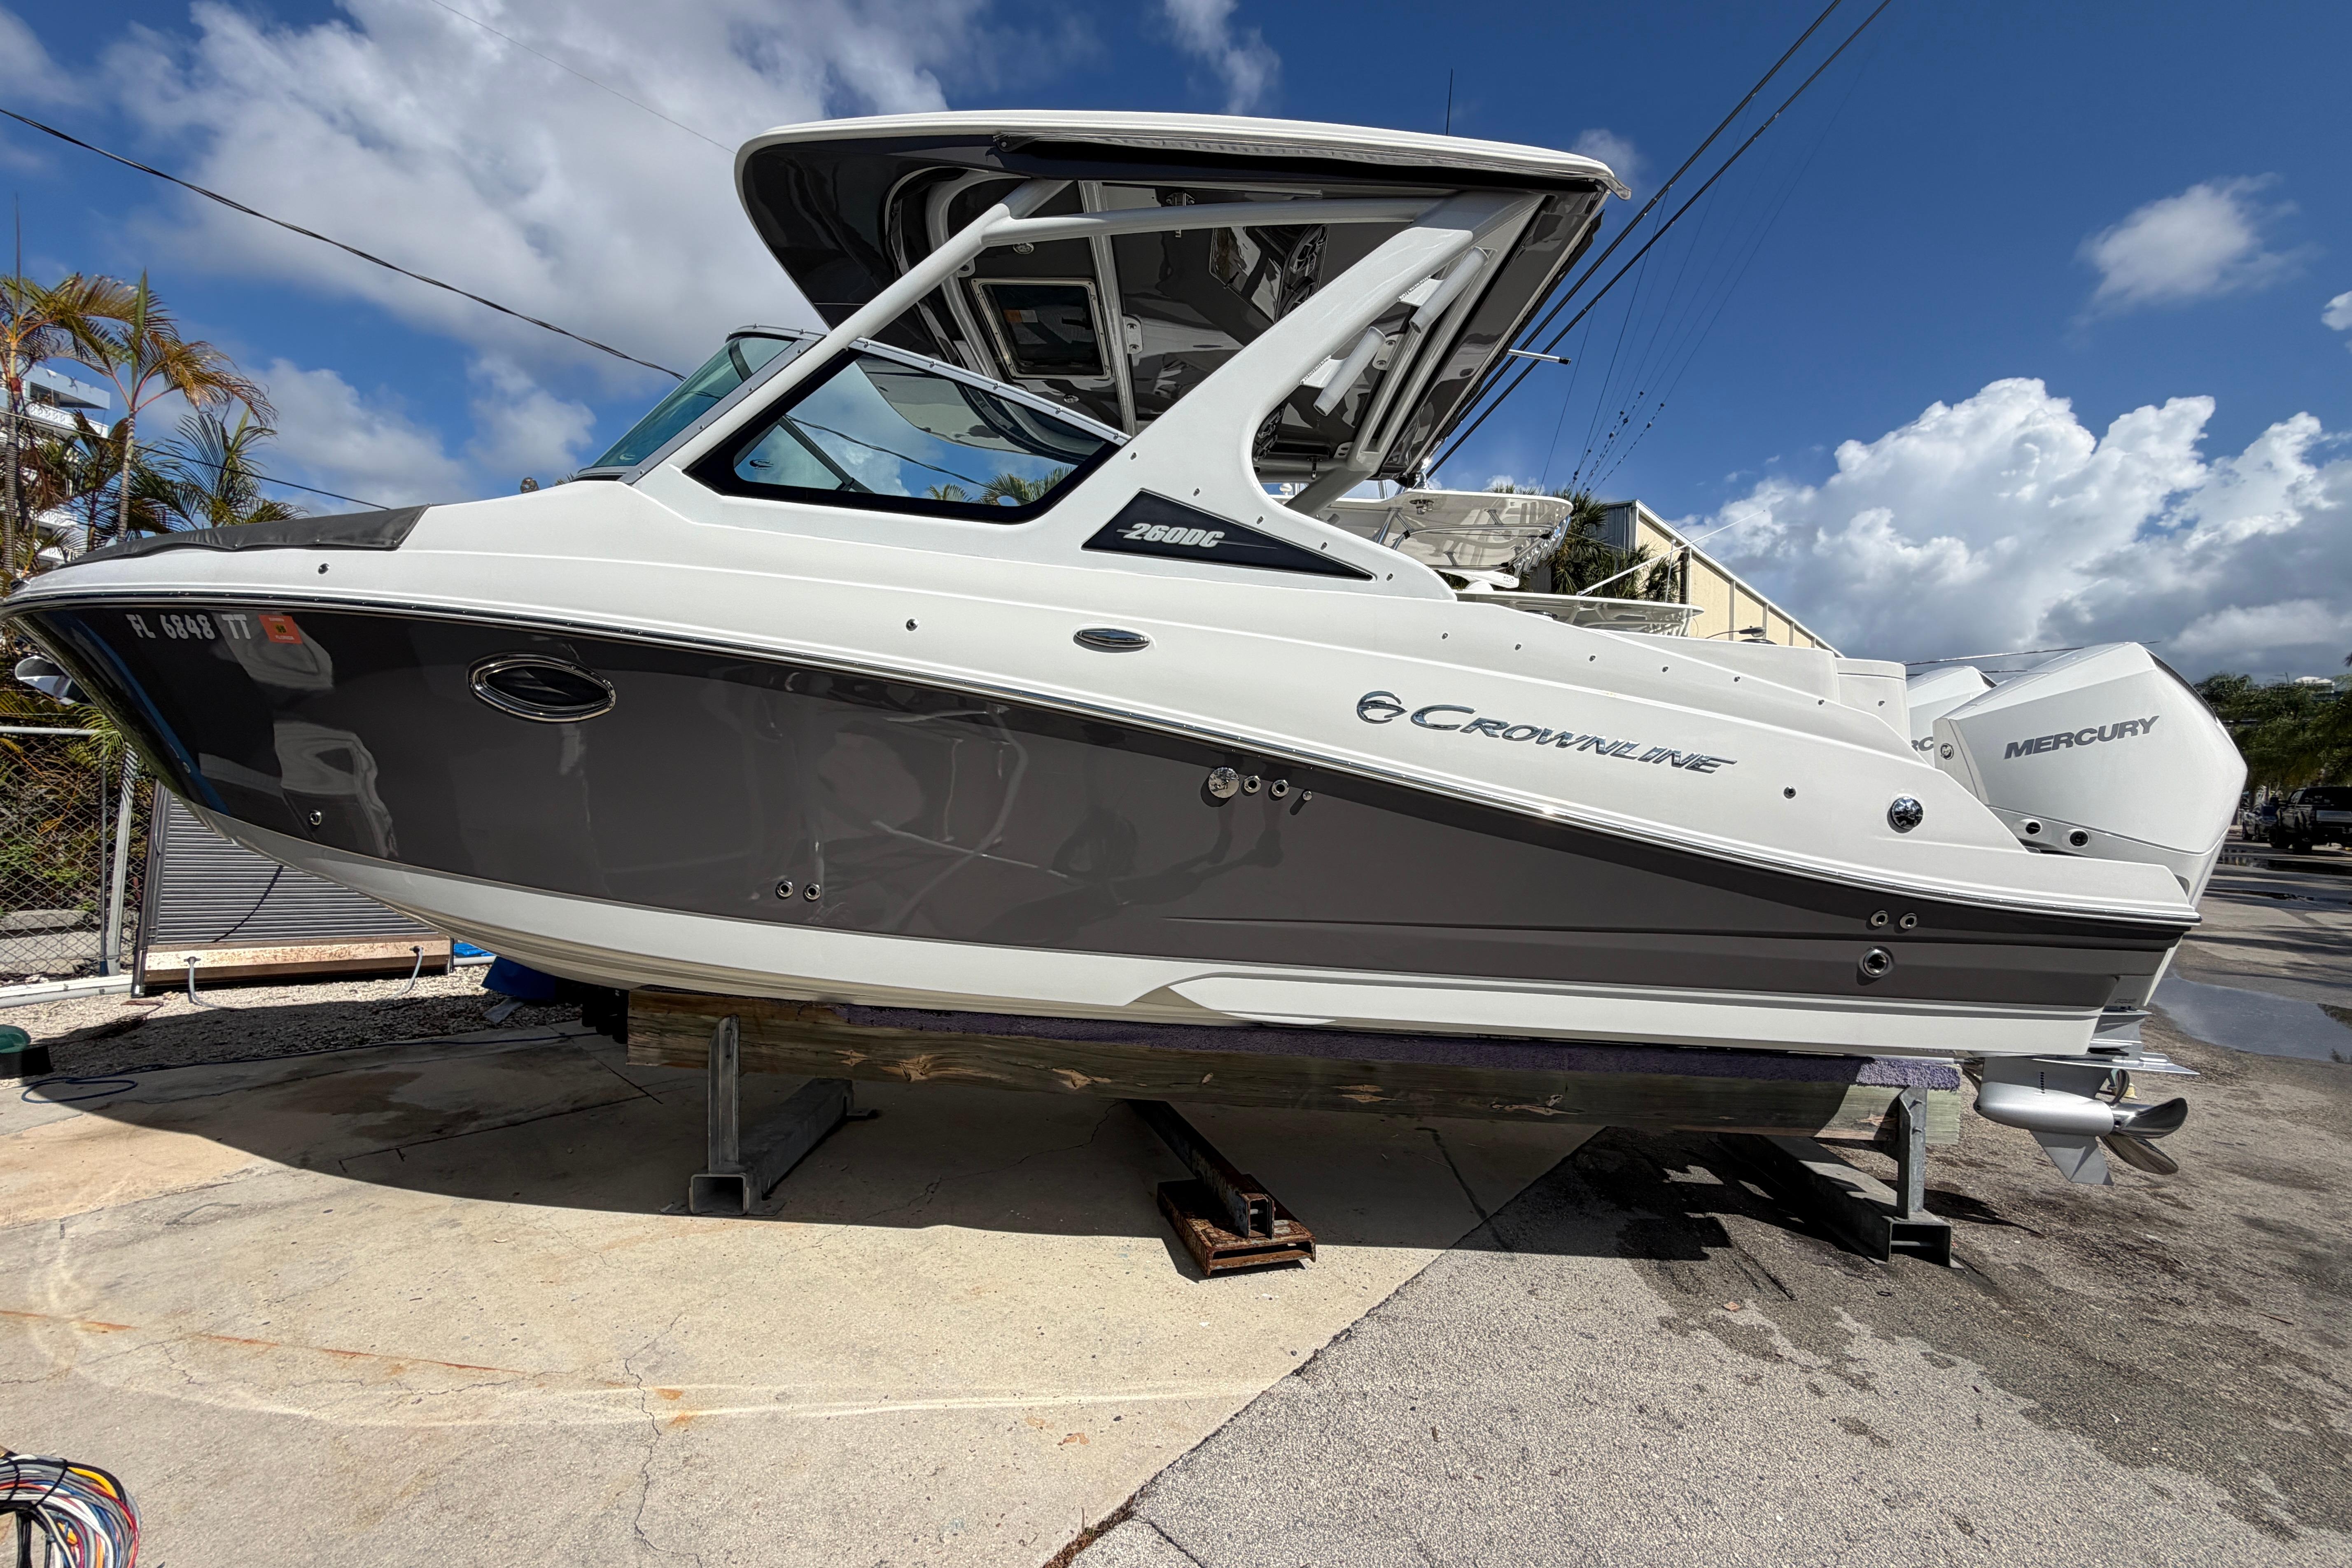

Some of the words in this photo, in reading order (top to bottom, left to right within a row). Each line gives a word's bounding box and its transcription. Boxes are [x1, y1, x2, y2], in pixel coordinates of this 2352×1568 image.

[1123, 523, 1225, 548] 260DC
[125, 614, 156, 638] FL
[160, 614, 215, 639] 6848
[222, 614, 251, 639] TT
[1411, 705, 1737, 773] CROWNLINE
[2004, 716, 2159, 759] MERCURY
